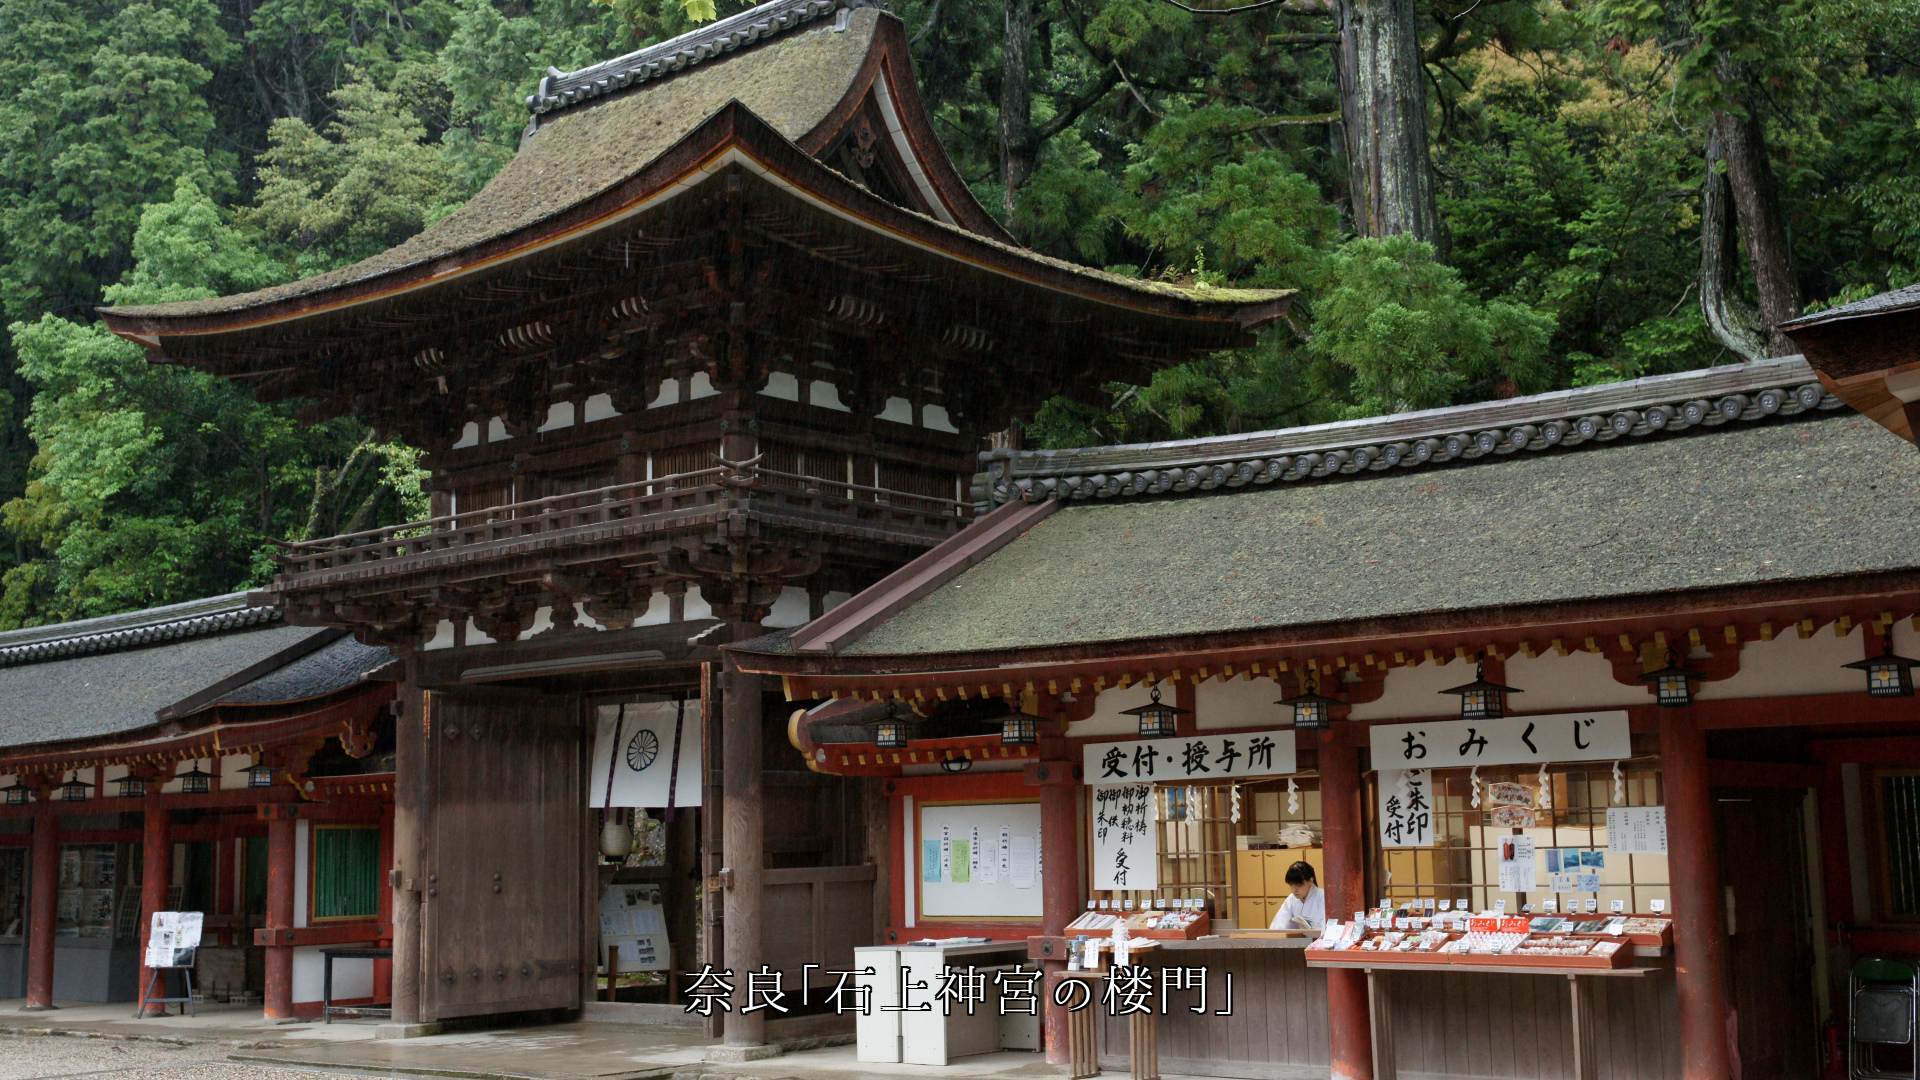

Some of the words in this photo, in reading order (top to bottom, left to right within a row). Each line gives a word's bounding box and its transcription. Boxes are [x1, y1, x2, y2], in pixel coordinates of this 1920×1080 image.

[1101, 736, 1276, 779] 受付・授与所
[1401, 718, 1595, 760] おみくじ
[1096, 788, 1108, 846] 御朱印
[1384, 794, 1404, 844] 受付
[1406, 769, 1430, 844] ご朱印
[1113, 847, 1130, 886] 受付
